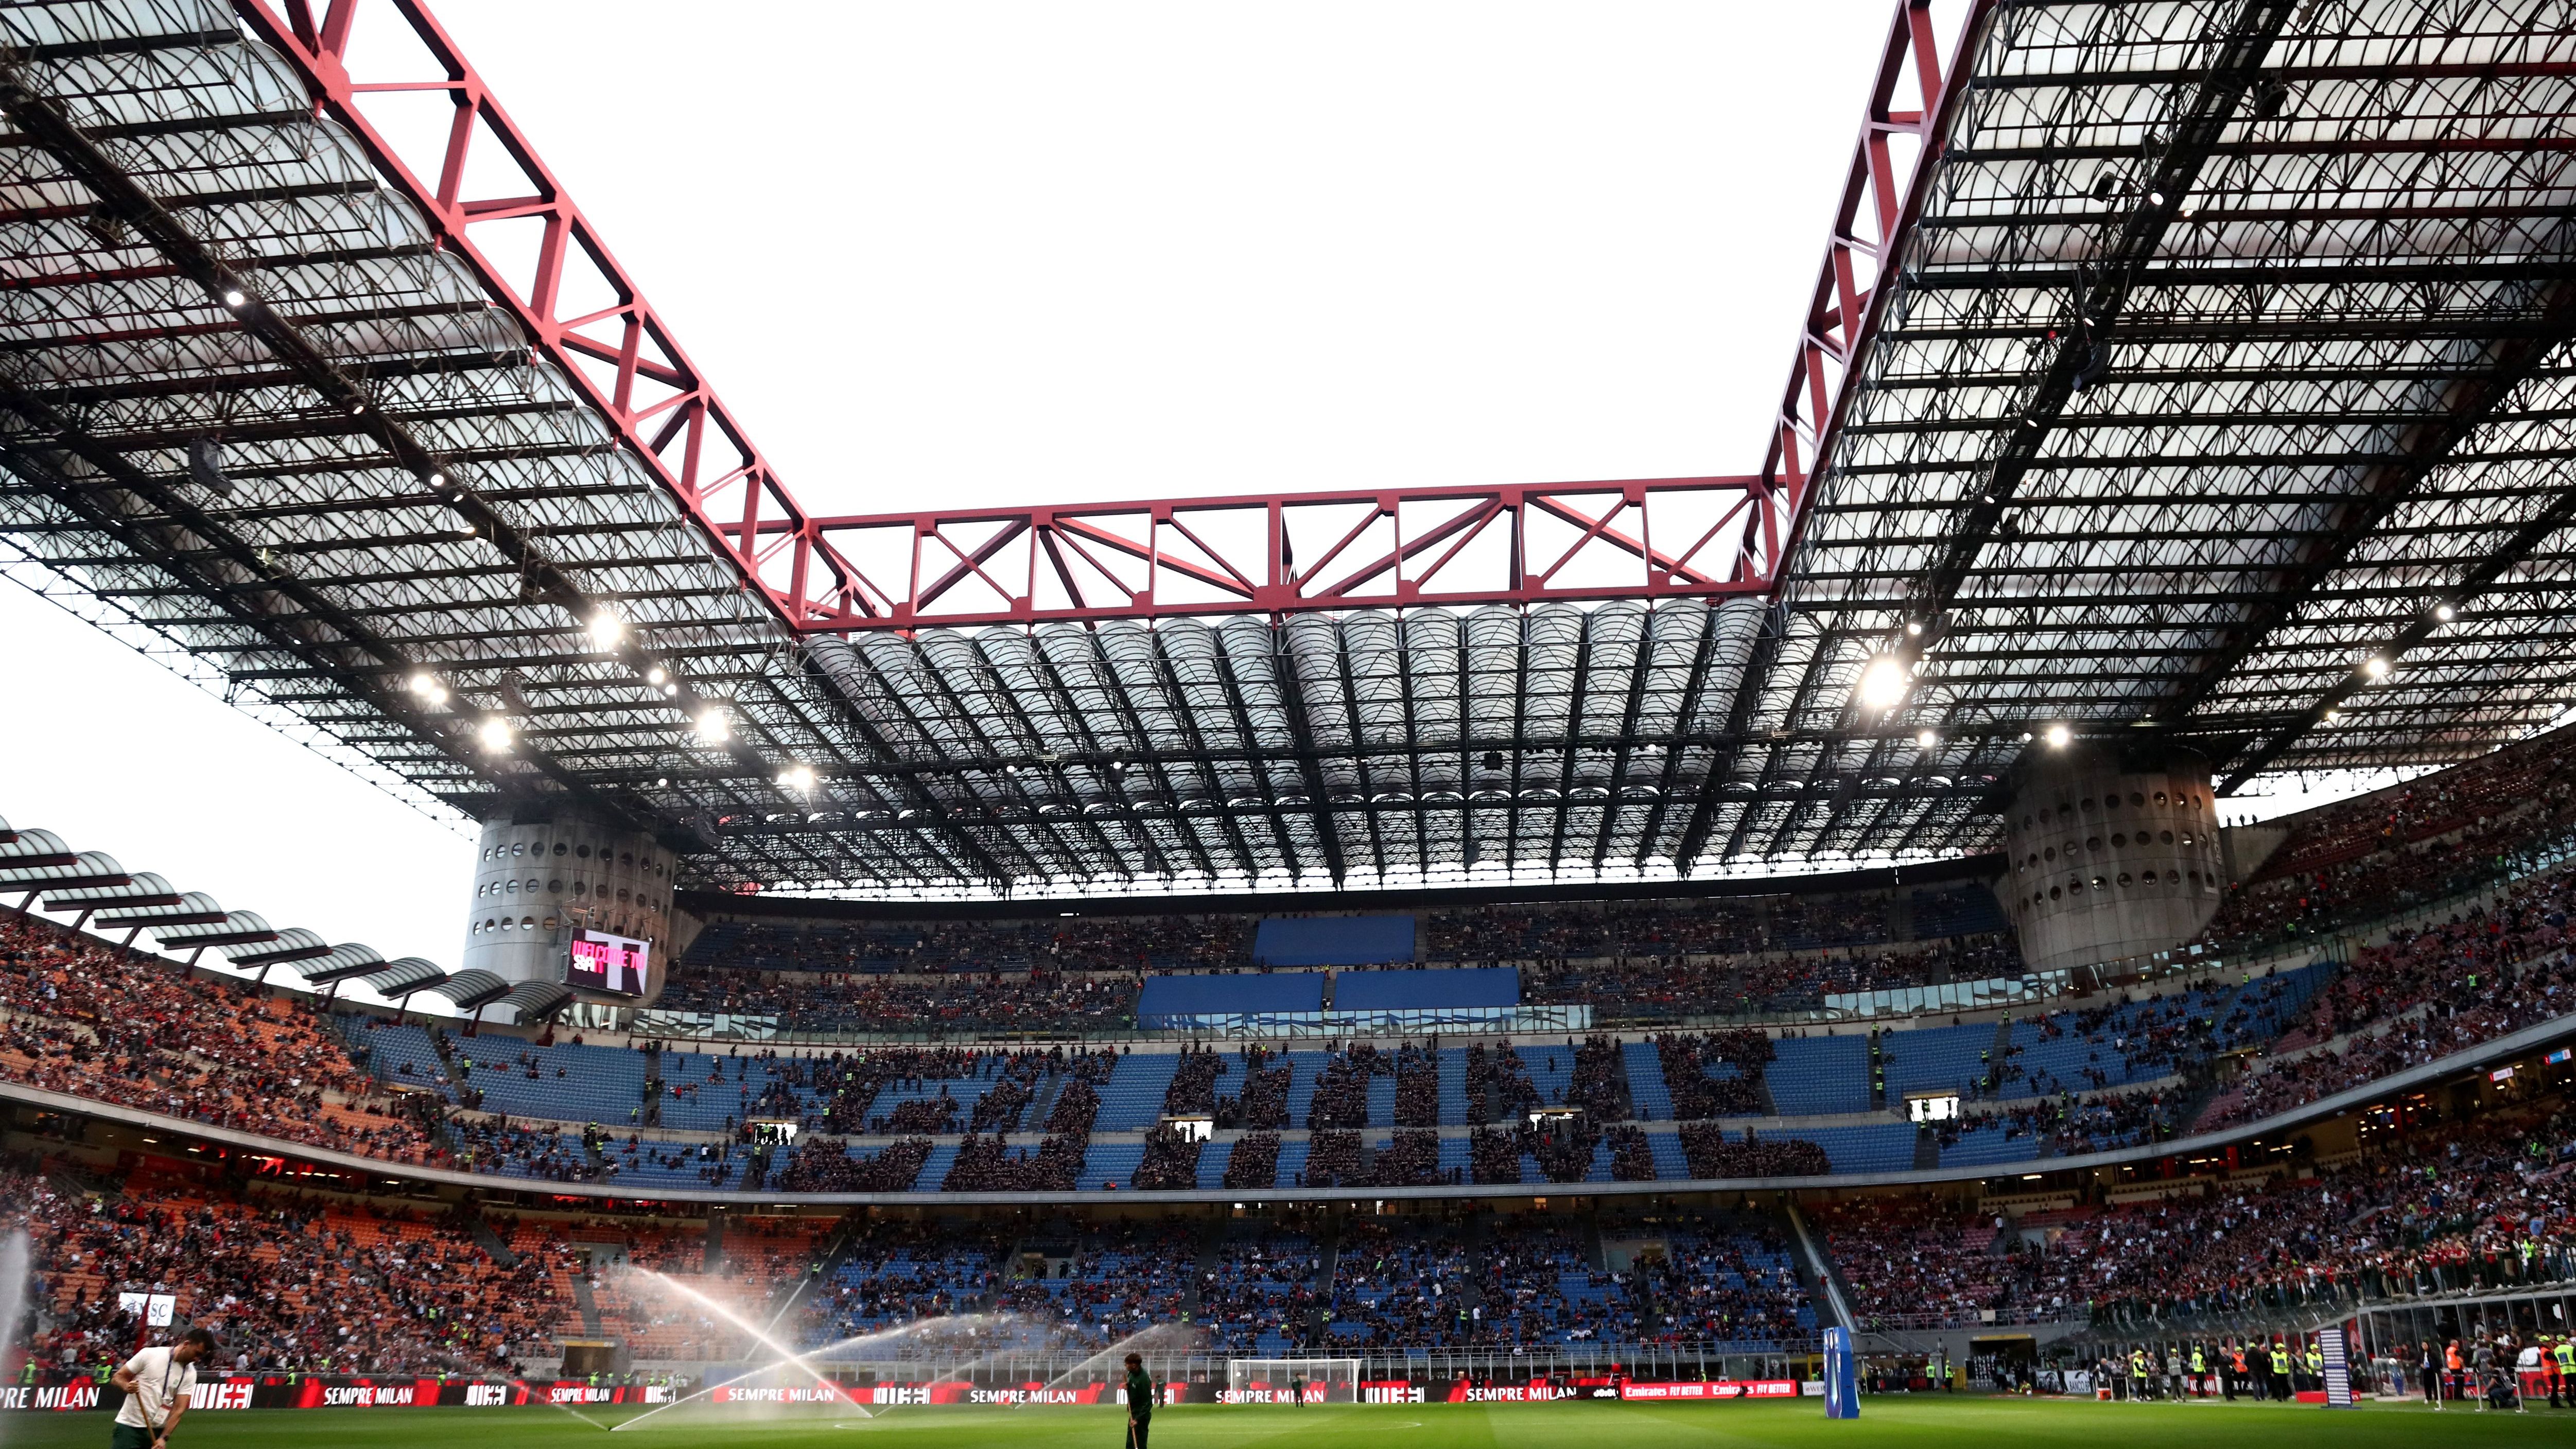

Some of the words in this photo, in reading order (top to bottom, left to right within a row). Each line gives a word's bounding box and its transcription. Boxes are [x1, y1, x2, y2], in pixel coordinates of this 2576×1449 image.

[572, 940, 628, 967] WELCOME
[630, 952, 646, 970] TO
[1625, 1387, 1667, 1397] Emirates
[1670, 1386, 1681, 1395] FLY
[1681, 1386, 1703, 1395] BETTER
[1712, 1385, 1754, 1395] Emiraes
[1768, 1383, 1790, 1393] BETTER
[2069, 1381, 2084, 1391] BANCO
[34, 1387, 100, 1408] MILAN
[324, 1387, 373, 1405] SEMPRE
[375, 1387, 413, 1404] MILAN
[551, 1388, 583, 1402] SEMPRE
[584, 1388, 610, 1402] MILAN
[728, 1388, 785, 1401] SEMPRE
[789, 1388, 834, 1401] MILAN
[970, 1390, 1025, 1403] SEMPRE
[1031, 1390, 1076, 1403] MILAN
[1215, 1390, 1272, 1403] SEMPRE
[1277, 1390, 1324, 1403] MIAN
[1467, 1387, 1524, 1401] SEMPRE
[1529, 1387, 1577, 1400] MILAN
